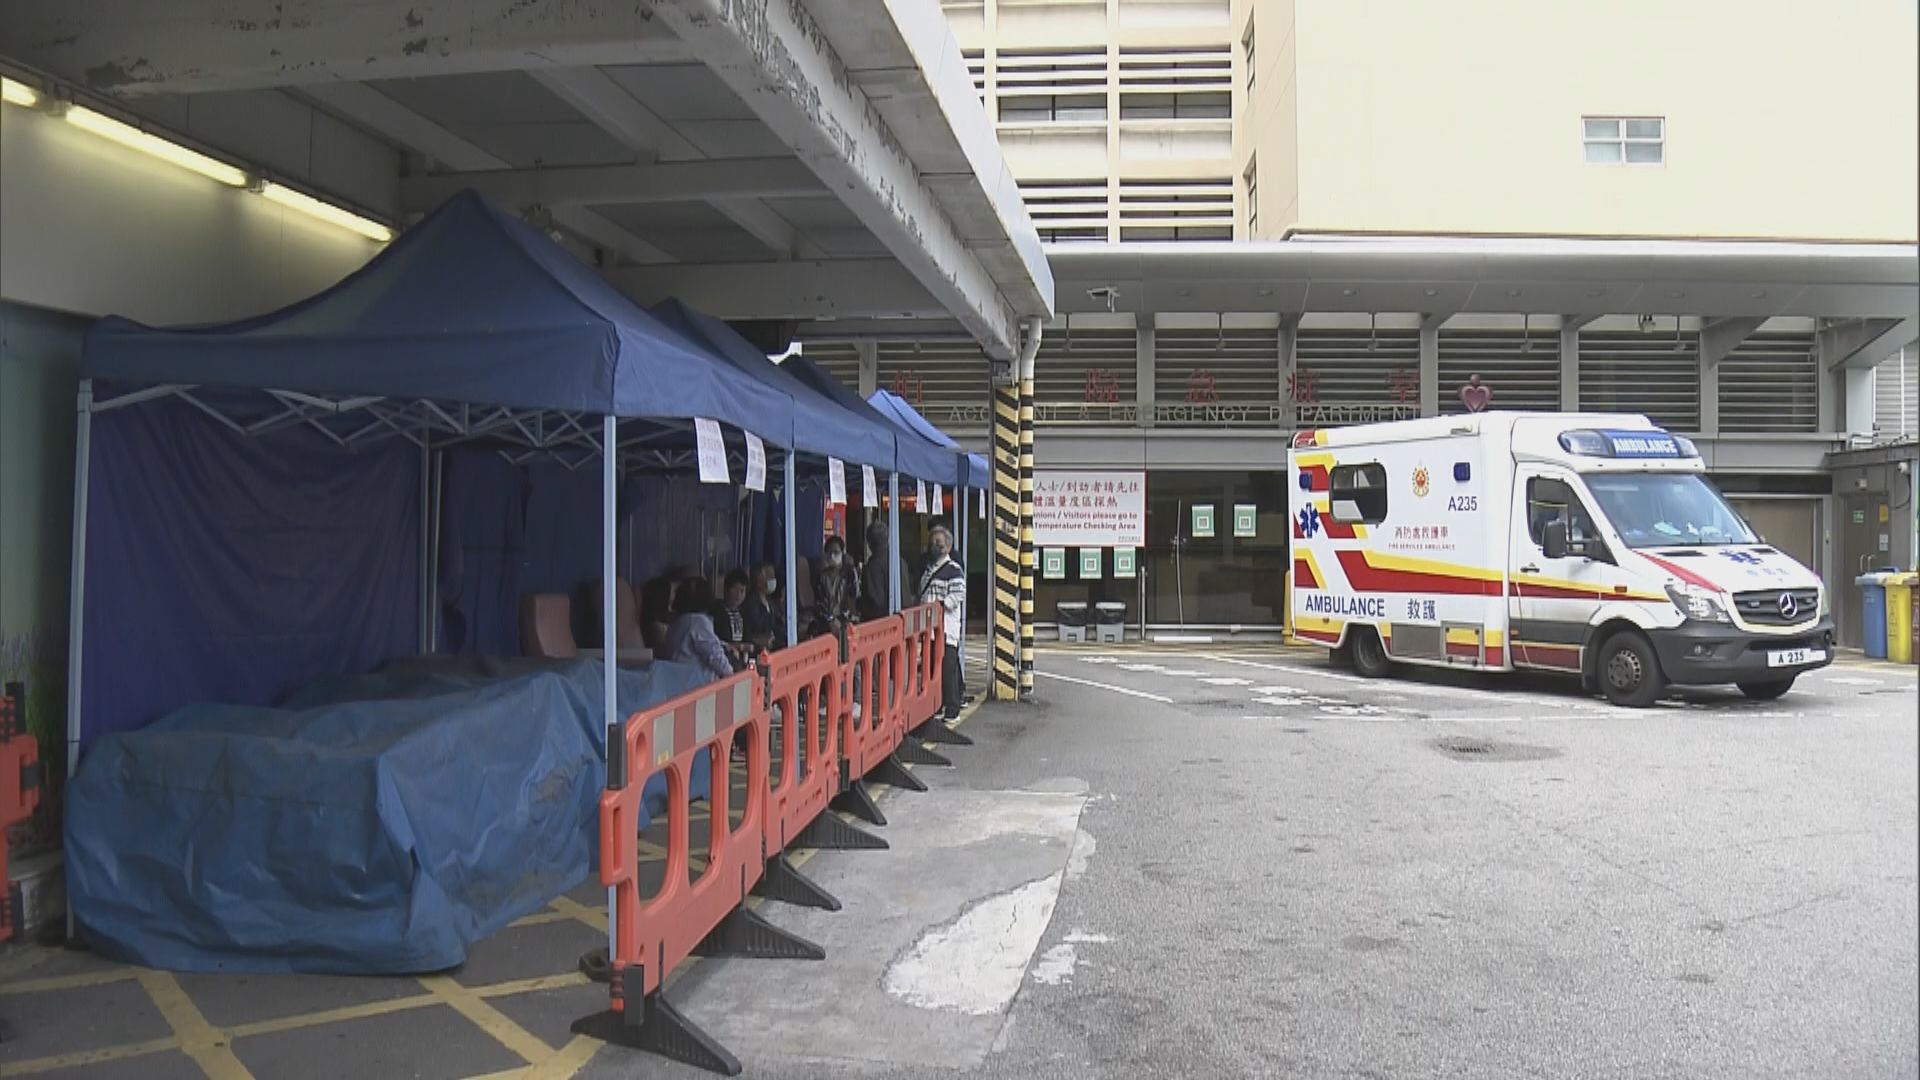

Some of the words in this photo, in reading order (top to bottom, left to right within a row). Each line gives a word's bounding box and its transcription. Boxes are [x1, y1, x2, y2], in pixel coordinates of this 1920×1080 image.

[1078, 406, 1089, 421] &
[1269, 405, 1420, 423] DPARTMENT
[1612, 437, 1678, 454] AMBULANCE
[1447, 495, 1478, 512] A235
[1057, 510, 1062, 520] /
[1063, 511, 1091, 519] Visitors
[1092, 511, 1117, 521] please
[1118, 512, 1128, 521] go
[1129, 511, 1138, 519] to
[1034, 522, 1082, 531] Temperature
[1083, 521, 1117, 531] Checking
[1118, 522, 1136, 530] Area
[1305, 594, 1385, 618] AMBULANCE
[1407, 598, 1437, 621] 救護
[1778, 653, 1784, 664] A
[1787, 651, 1804, 664] 235
